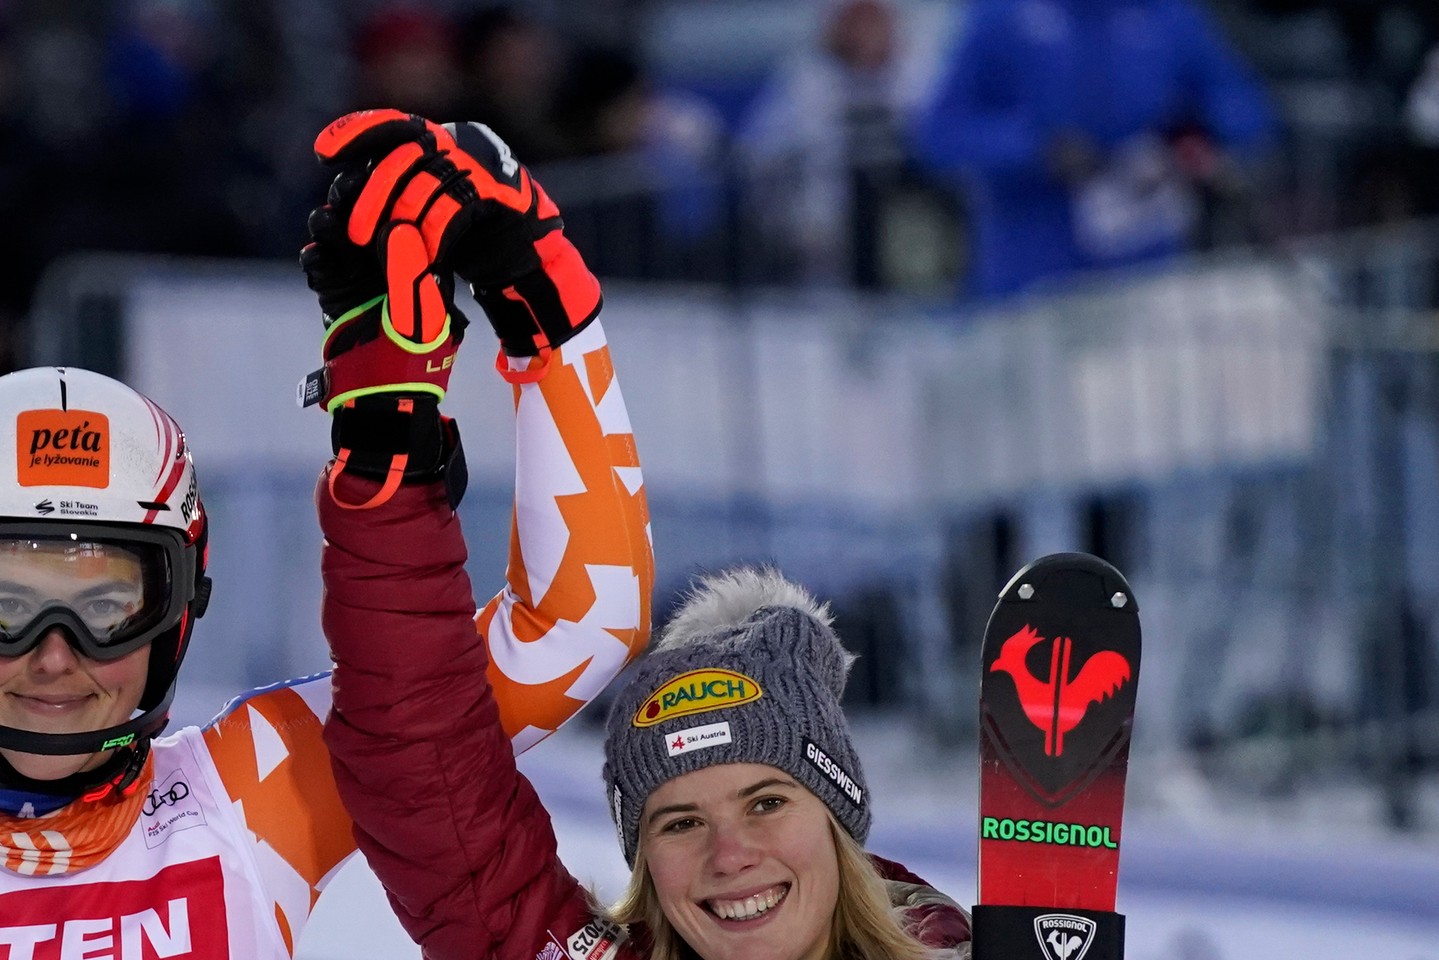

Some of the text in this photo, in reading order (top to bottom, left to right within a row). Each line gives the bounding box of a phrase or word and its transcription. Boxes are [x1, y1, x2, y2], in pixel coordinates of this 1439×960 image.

[425, 353, 456, 374] LE
[29, 453, 101, 469] je lyžovanie
[59, 500, 99, 511] Ski Team
[661, 679, 746, 711] RAUCH
[686, 729, 727, 744] Ski Austria
[806, 742, 863, 805] GIESSWEIN
[982, 816, 1119, 849] ROSSIGNOL
[1042, 919, 1088, 933] ROSSIGNOL
